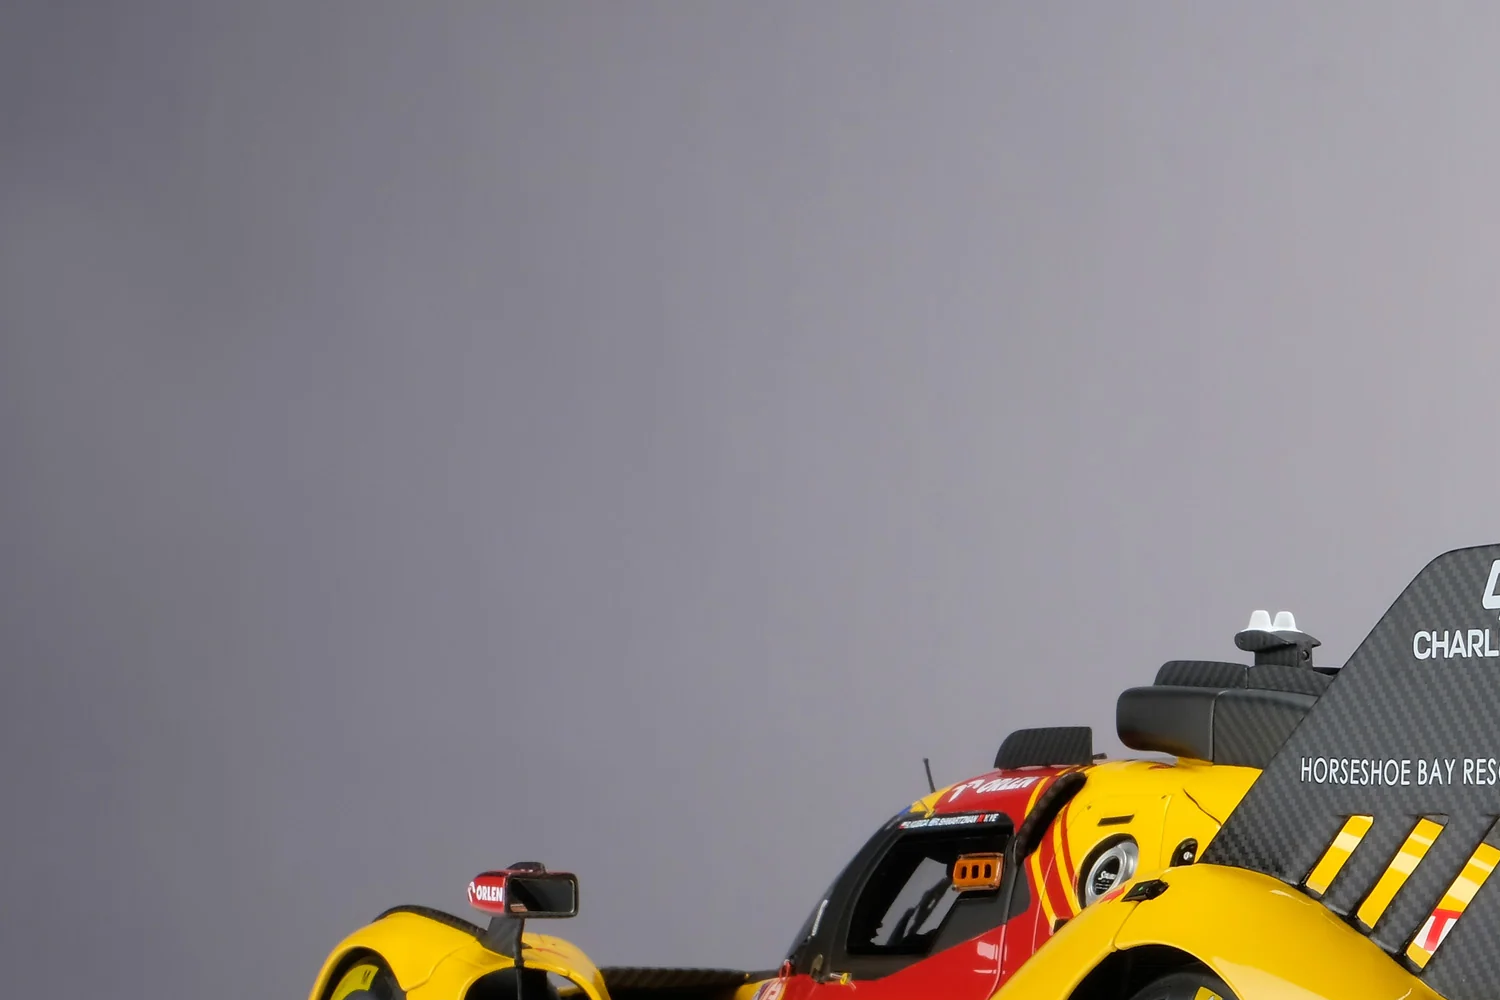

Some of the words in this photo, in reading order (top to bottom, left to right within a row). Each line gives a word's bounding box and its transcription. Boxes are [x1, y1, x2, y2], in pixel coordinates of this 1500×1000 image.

[1300, 756, 1411, 786] HORSESHOE
[1417, 758, 1456, 785] BAY
[976, 776, 1040, 794] ORLEN
[476, 885, 503, 902] ORLEN
